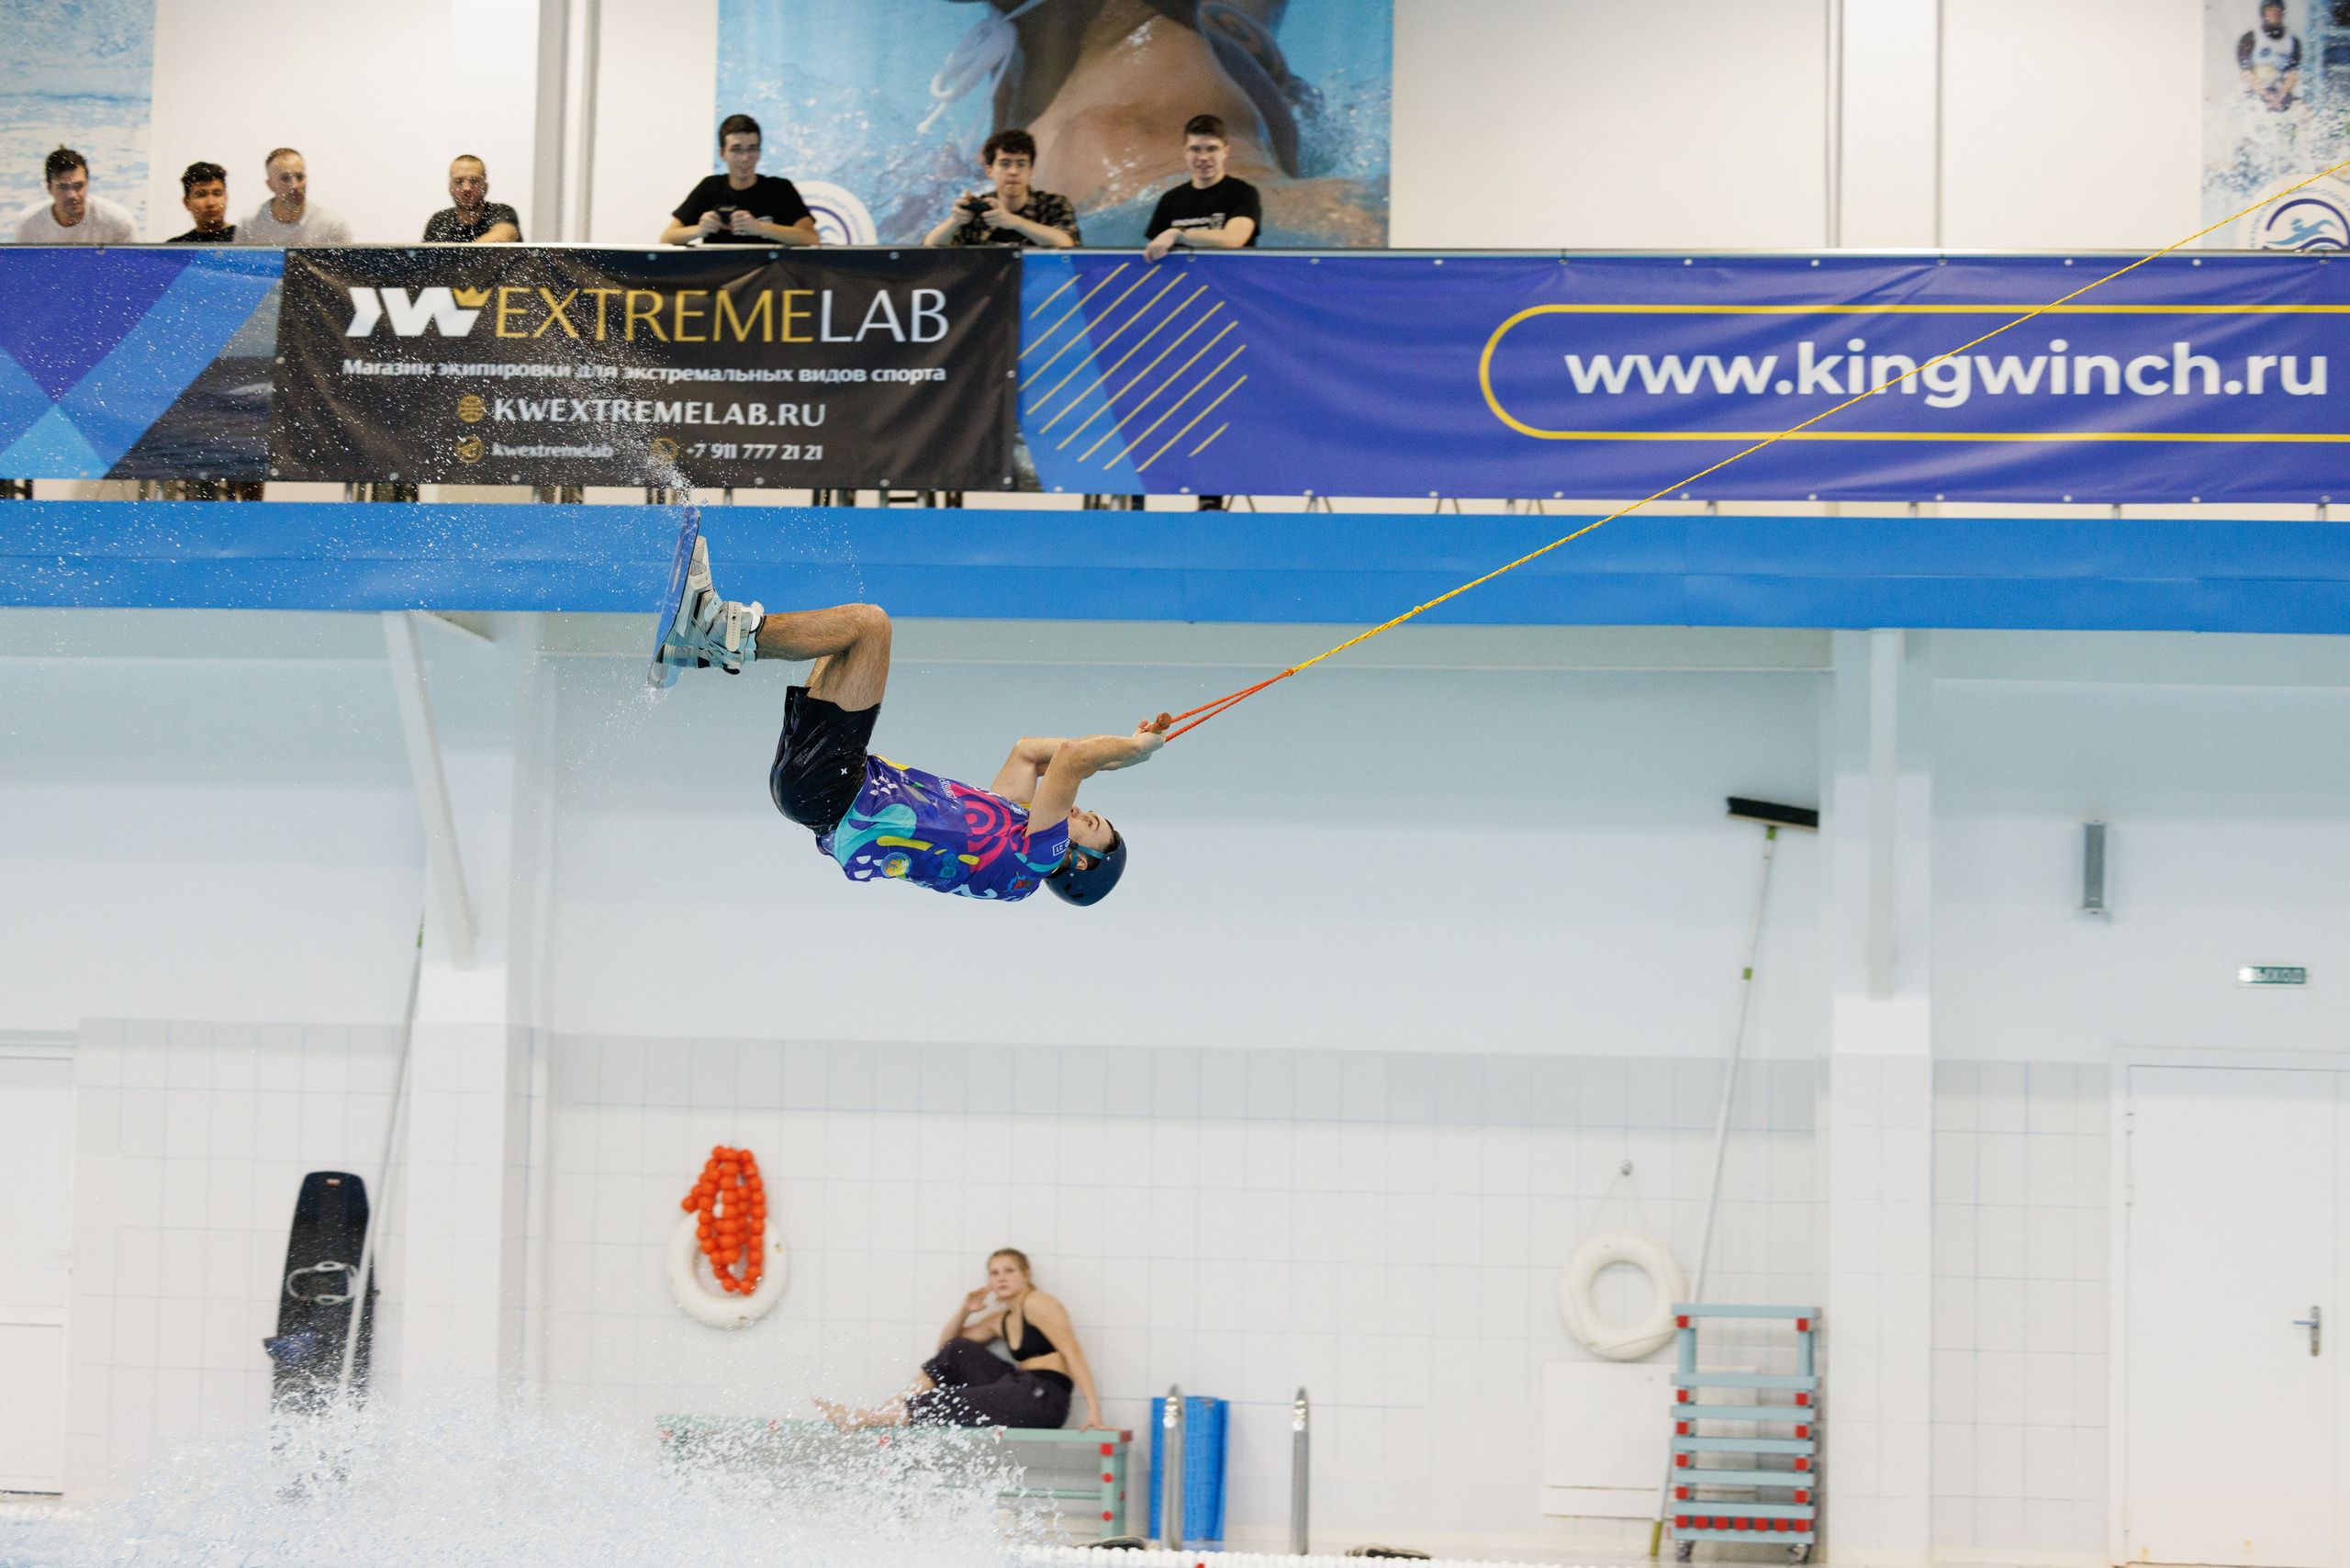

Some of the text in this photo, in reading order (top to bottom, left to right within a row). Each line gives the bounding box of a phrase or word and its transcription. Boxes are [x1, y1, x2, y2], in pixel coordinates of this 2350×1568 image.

[494, 286, 950, 343] EXTREMELAB
[342, 359, 946, 386] Магазин экипировки для экстремальных видов спорта
[1563, 338, 2329, 409] www.kingwinch.ru
[493, 398, 826, 427] KWEXTREMELAB.RU
[491, 442, 614, 459] kwextremelab
[711, 442, 738, 460] 911
[742, 443, 778, 460] 777
[780, 444, 801, 461] 21
[803, 444, 824, 461] 21
